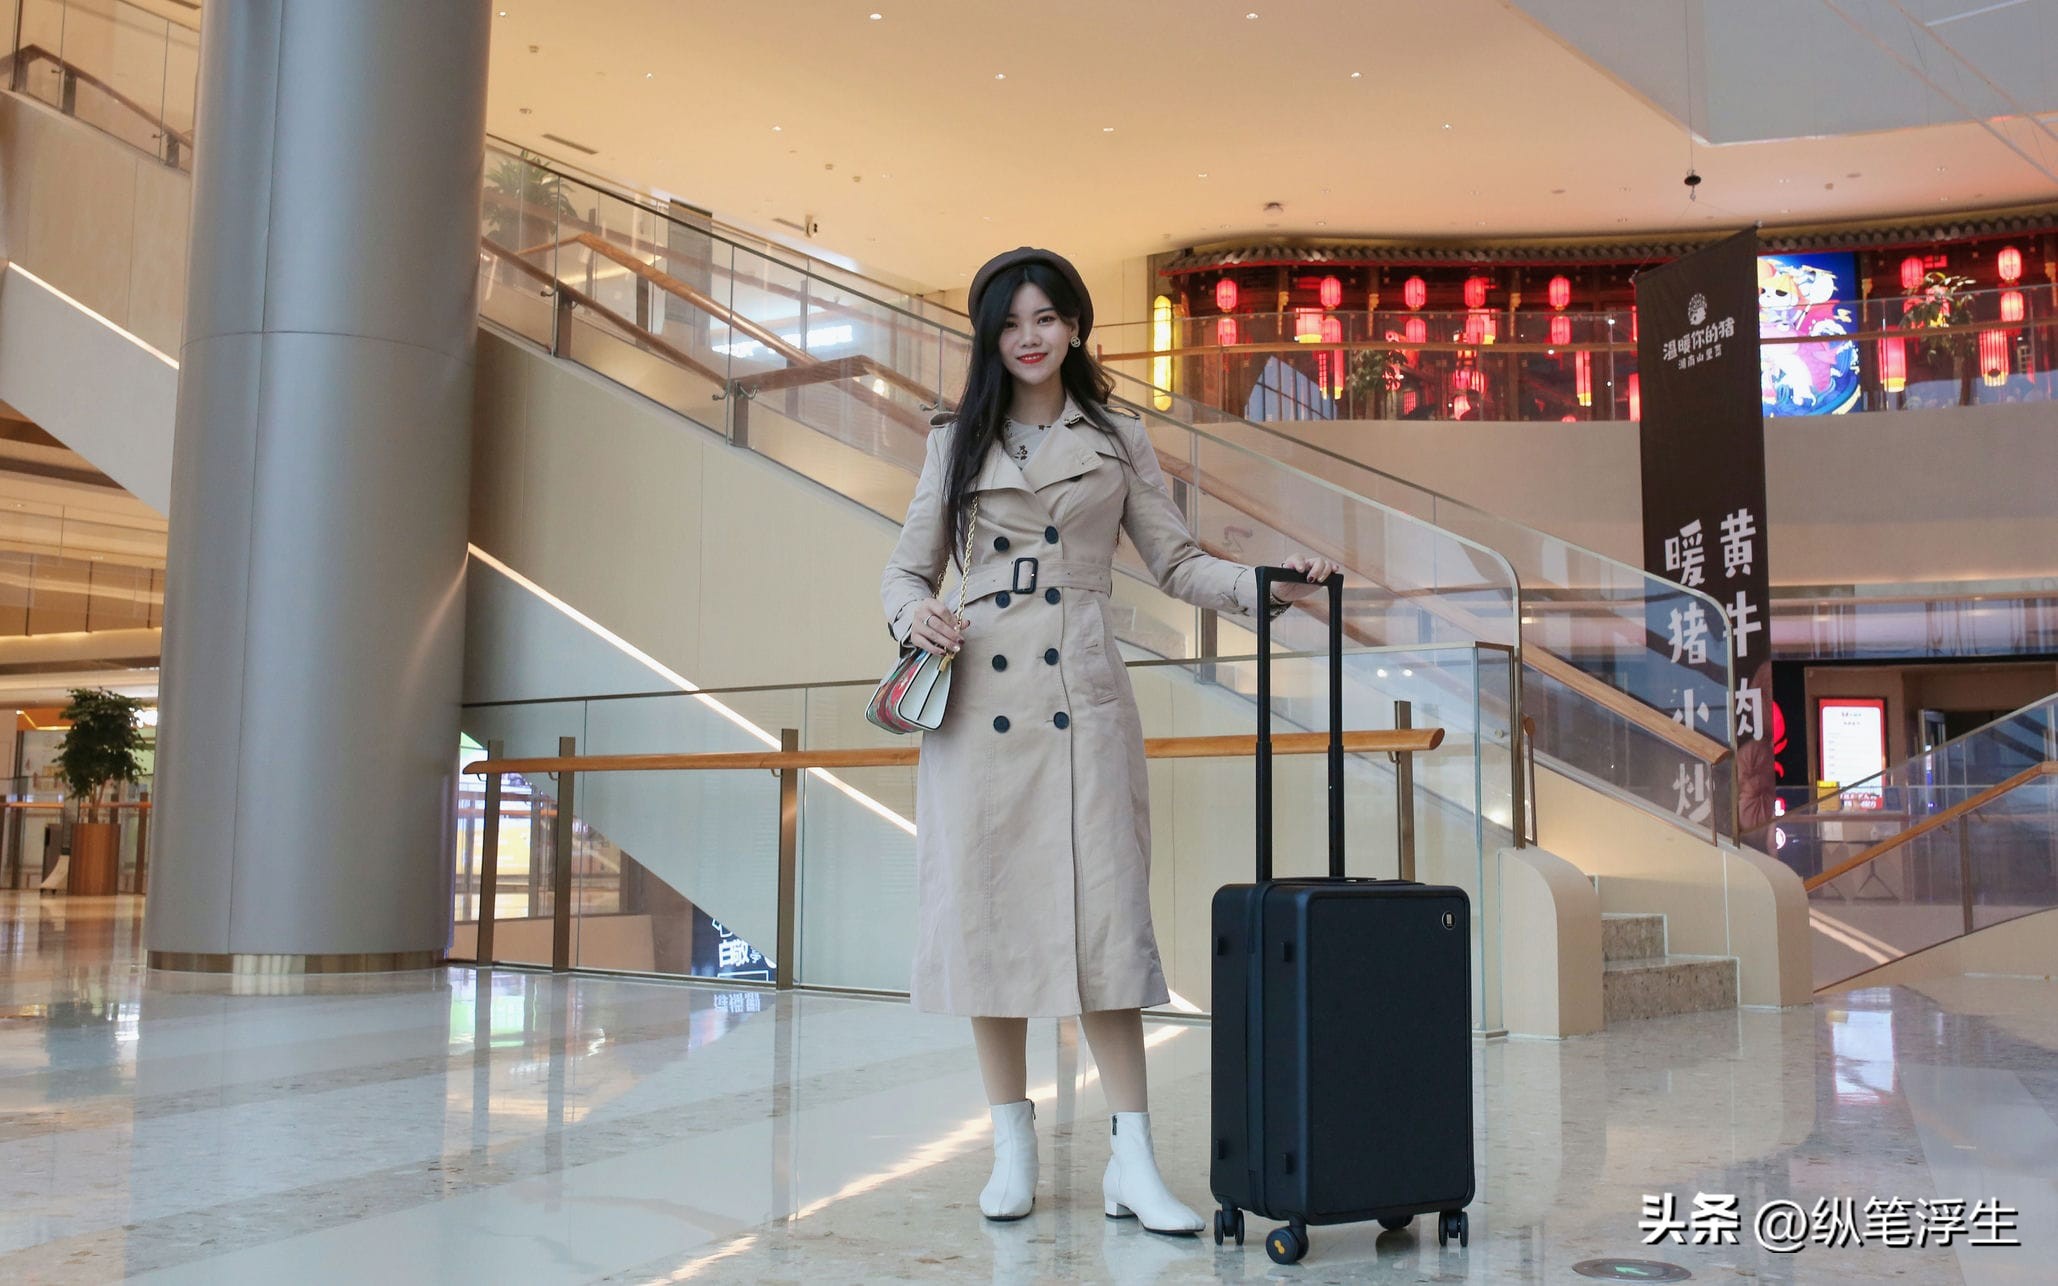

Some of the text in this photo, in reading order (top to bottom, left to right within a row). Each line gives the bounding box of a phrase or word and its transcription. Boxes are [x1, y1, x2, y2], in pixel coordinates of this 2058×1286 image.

[1663, 316, 1735, 361] 温暖你的猪
